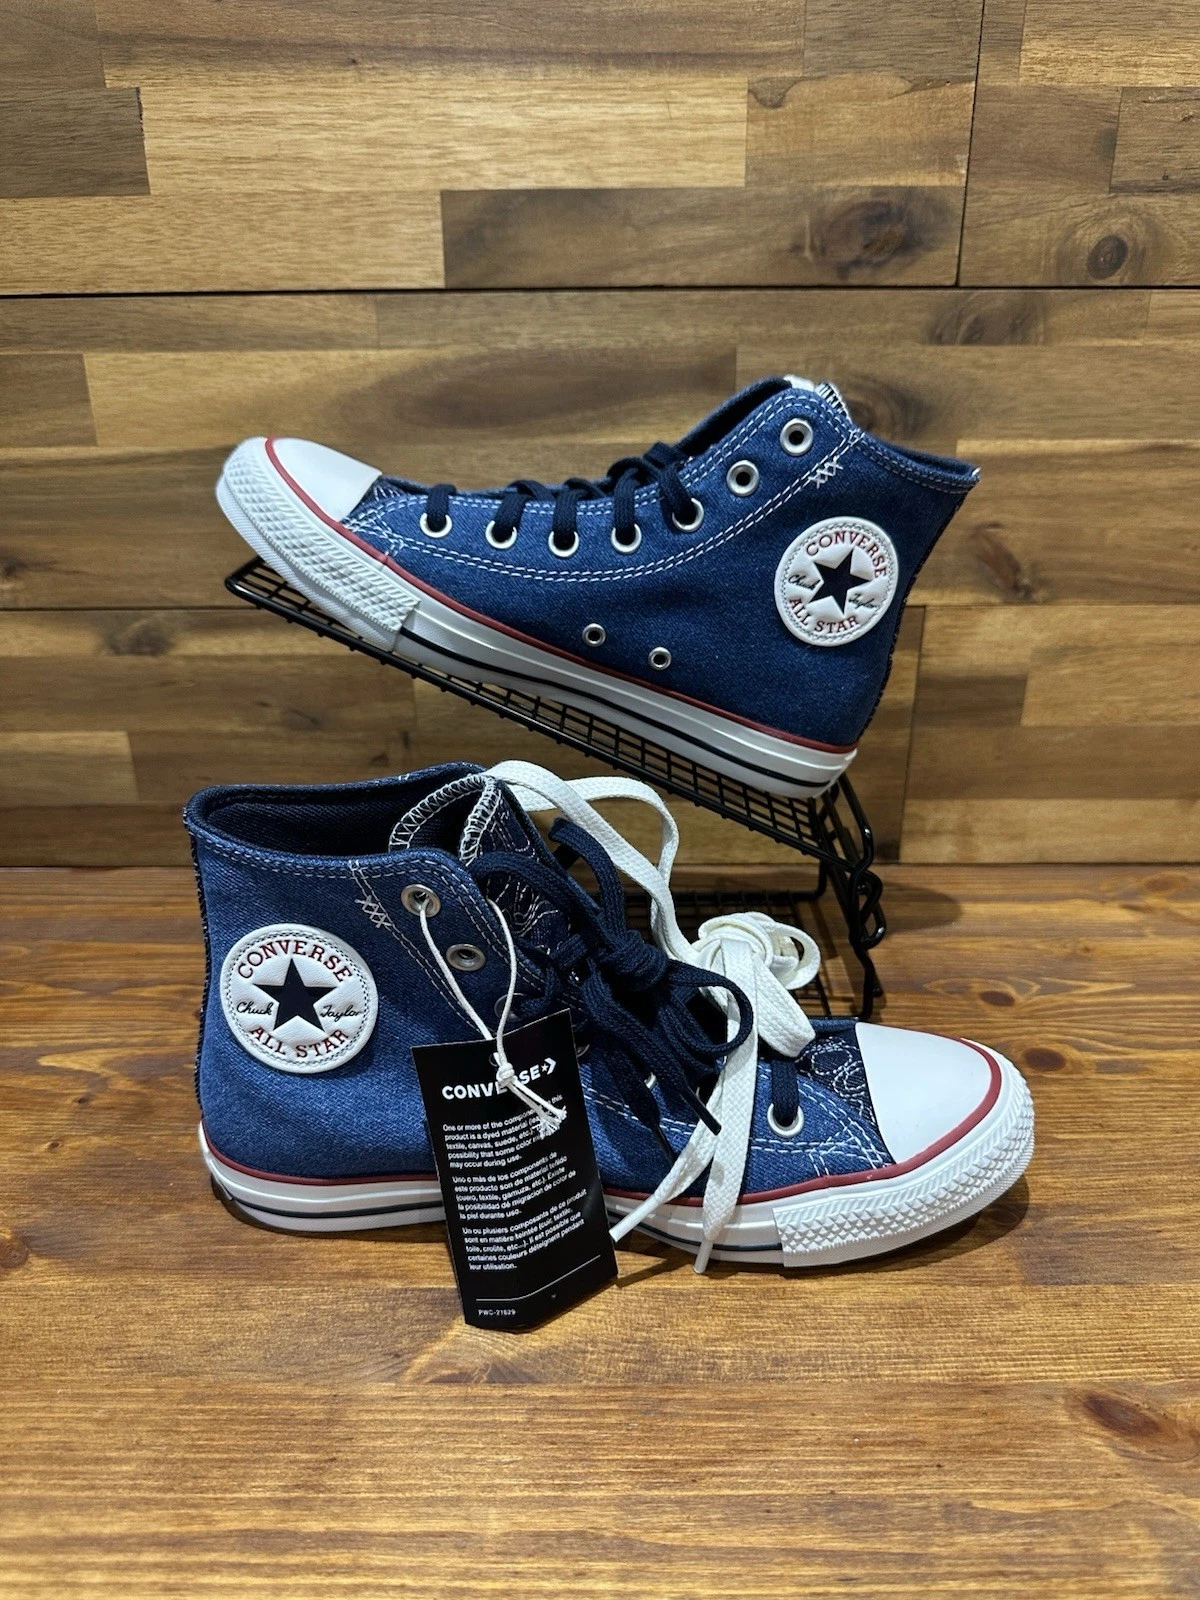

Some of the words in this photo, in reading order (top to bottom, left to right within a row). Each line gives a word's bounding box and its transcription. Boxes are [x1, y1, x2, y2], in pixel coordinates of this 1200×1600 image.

[806, 530, 887, 578] CONVERSE
[789, 597, 810, 626] ALL
[815, 615, 859, 633] STAR
[238, 939, 353, 983] CONVERSE
[236, 1001, 273, 1016] Chuck
[320, 1004, 363, 1023] Taylor
[250, 1027, 287, 1056] ALL
[296, 1029, 350, 1059] STAR
[442, 1065, 541, 1100] CONVESE
[482, 1122, 490, 1130] of
[491, 1121, 503, 1129] the
[482, 1130, 500, 1140] dyed
[501, 1120, 528, 1136] material
[448, 1152, 480, 1160] possibility
[495, 1146, 516, 1156] some
[516, 1138, 532, 1150] color
[494, 1136, 519, 1147] suede,
[450, 1162, 464, 1170] may
[484, 1159, 506, 1167] during
[507, 1154, 522, 1164] use.
[452, 1176, 466, 1184] Uno
[549, 1152, 558, 1160] de
[464, 1203, 500, 1212] posibilidad
[544, 1183, 552, 1192] de
[552, 1174, 568, 1186] color
[568, 1170, 576, 1178] de
[469, 1184, 498, 1194] producto
[500, 1182, 514, 1190] son
[514, 1178, 524, 1186] de
[524, 1164, 548, 1182] material
[502, 1186, 531, 1200] gamuza,
[548, 1166, 566, 1180] Existe
[466, 1212, 479, 1220] piel
[506, 1208, 522, 1218] uso.
[510, 1211, 549, 1232] composants
[550, 1206, 558, 1214] de
[558, 1200, 566, 1209] ce
[566, 1188, 587, 1206] produit
[554, 1208, 573, 1220] textile,
[498, 1250, 528, 1261] couleurs
[560, 1218, 584, 1238] pendant
[534, 1232, 544, 1241] est
[544, 1218, 570, 1236] possible
[570, 1212, 581, 1221] que
[469, 1262, 482, 1270] leur
[482, 1262, 518, 1270] utilisation.
